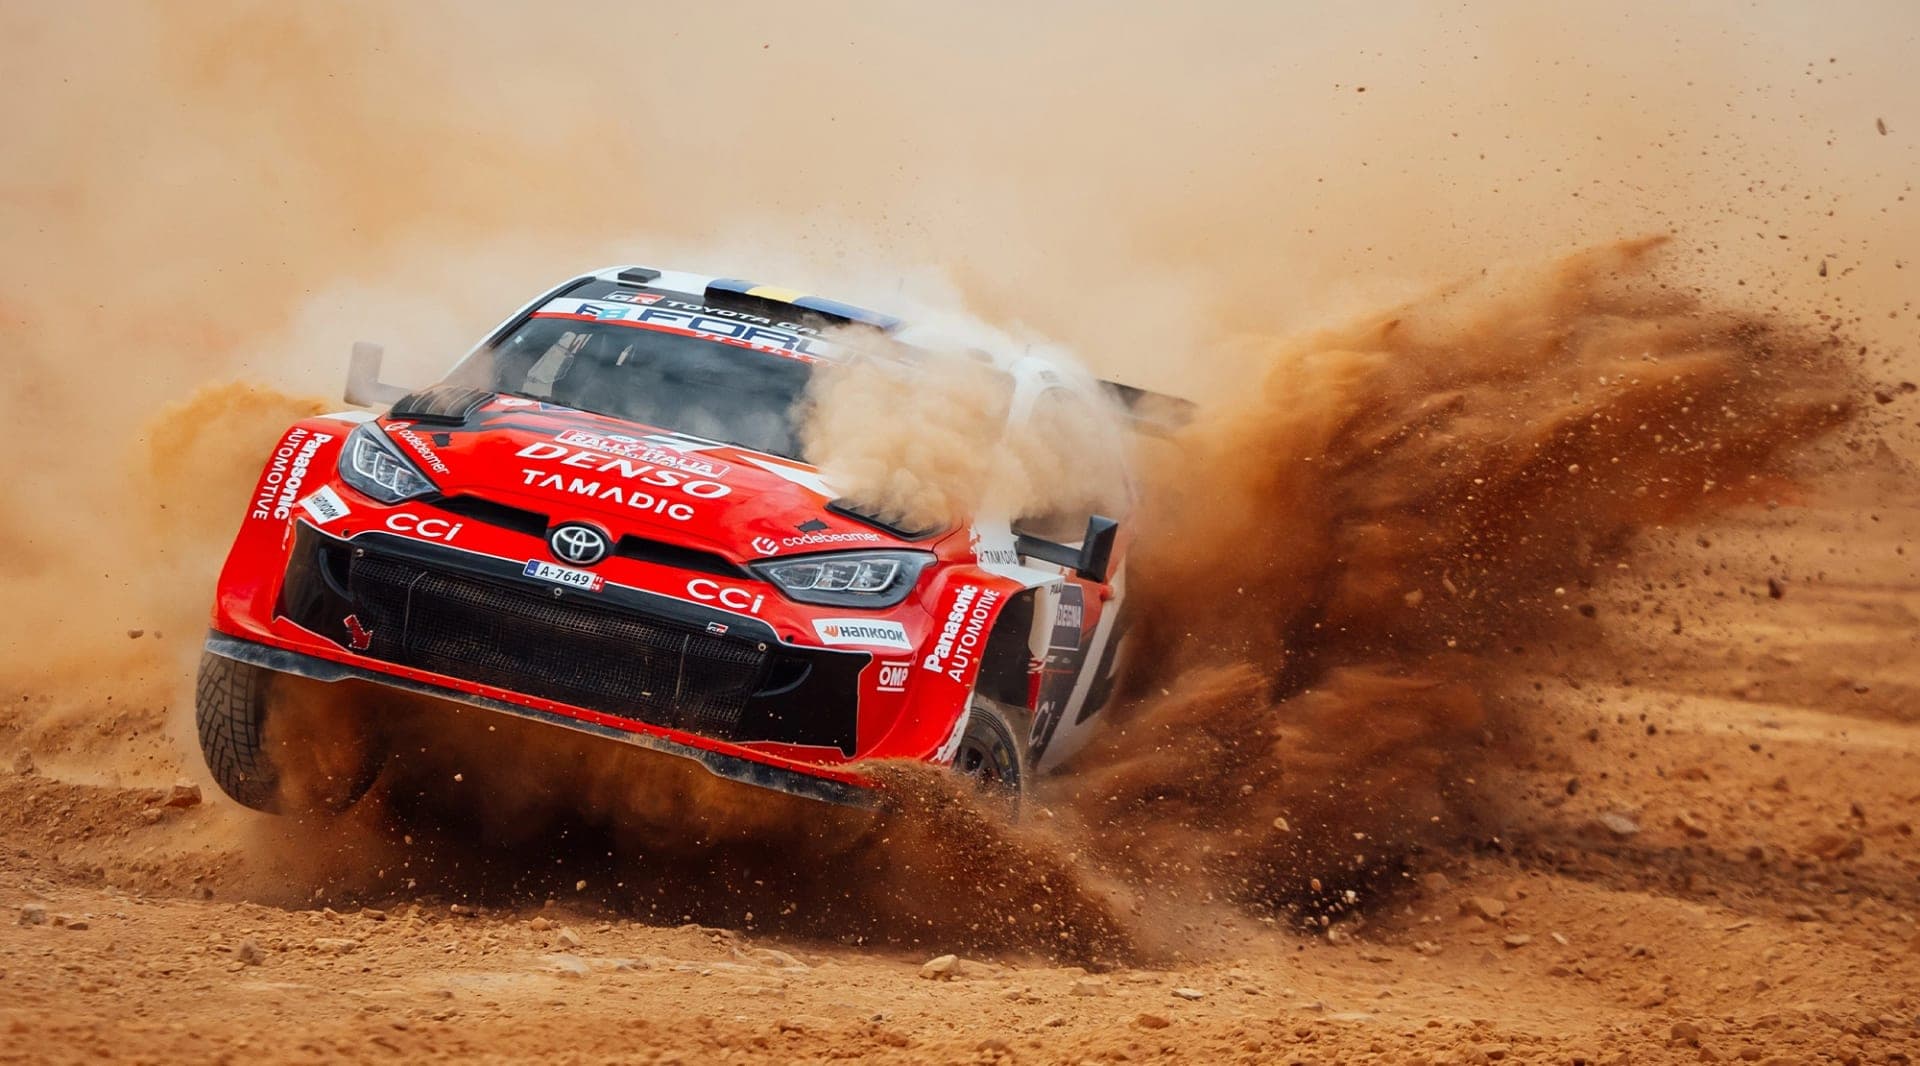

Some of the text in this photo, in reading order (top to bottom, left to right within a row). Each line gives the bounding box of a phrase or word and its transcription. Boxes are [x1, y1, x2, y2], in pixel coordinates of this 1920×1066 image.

[665, 300, 770, 324] TOYOTA
[252, 428, 309, 520] AUTOMOTIVE
[273, 432, 334, 520] Panasonic
[399, 429, 450, 474] codebeamer
[515, 442, 732, 499] DENSO
[521, 469, 695, 521] TAMADIC
[782, 531, 881, 547] codebeamer
[540, 566, 590, 585] A-7649
[922, 584, 979, 674] Panasonic
[947, 587, 1001, 683] AUTOMOTIVE
[879, 666, 909, 688] OMP
